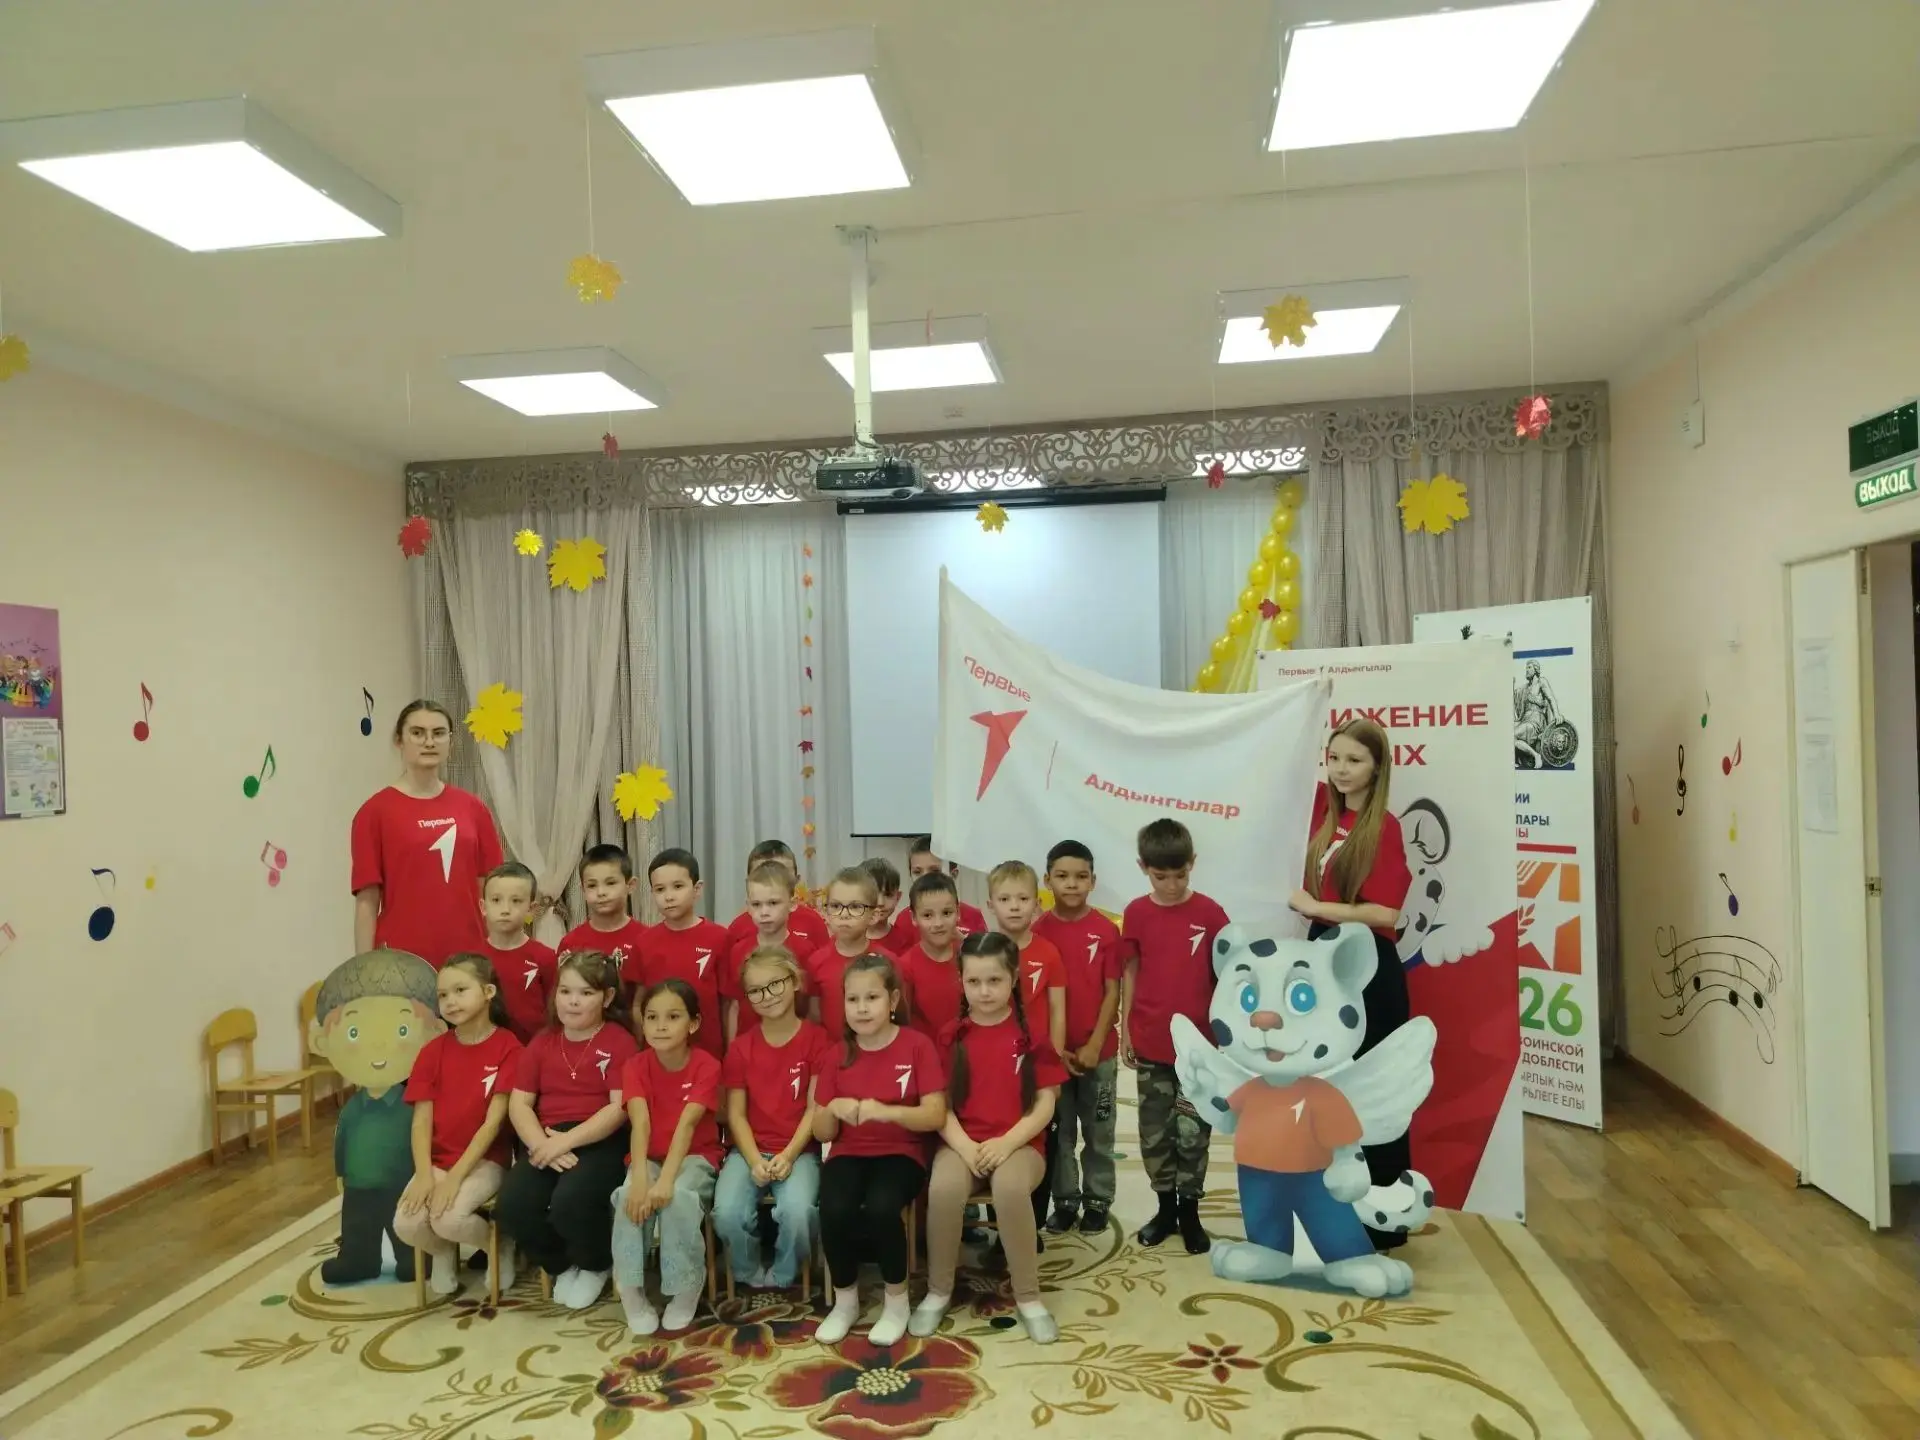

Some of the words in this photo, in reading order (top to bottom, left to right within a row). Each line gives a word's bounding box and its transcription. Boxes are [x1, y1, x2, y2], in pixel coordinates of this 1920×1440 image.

[1859, 468, 1911, 503] ВЫХОД
[964, 655, 1031, 702] Первые
[1278, 667, 1316, 676] Первые
[1324, 704, 1489, 730] ИЖЕНИЕ
[1084, 772, 1240, 820] Алдынгылар
[417, 817, 456, 828] Первые
[1519, 976, 1583, 1037] 26
[1522, 1052, 1584, 1074] ДОБЛЕСТИ
